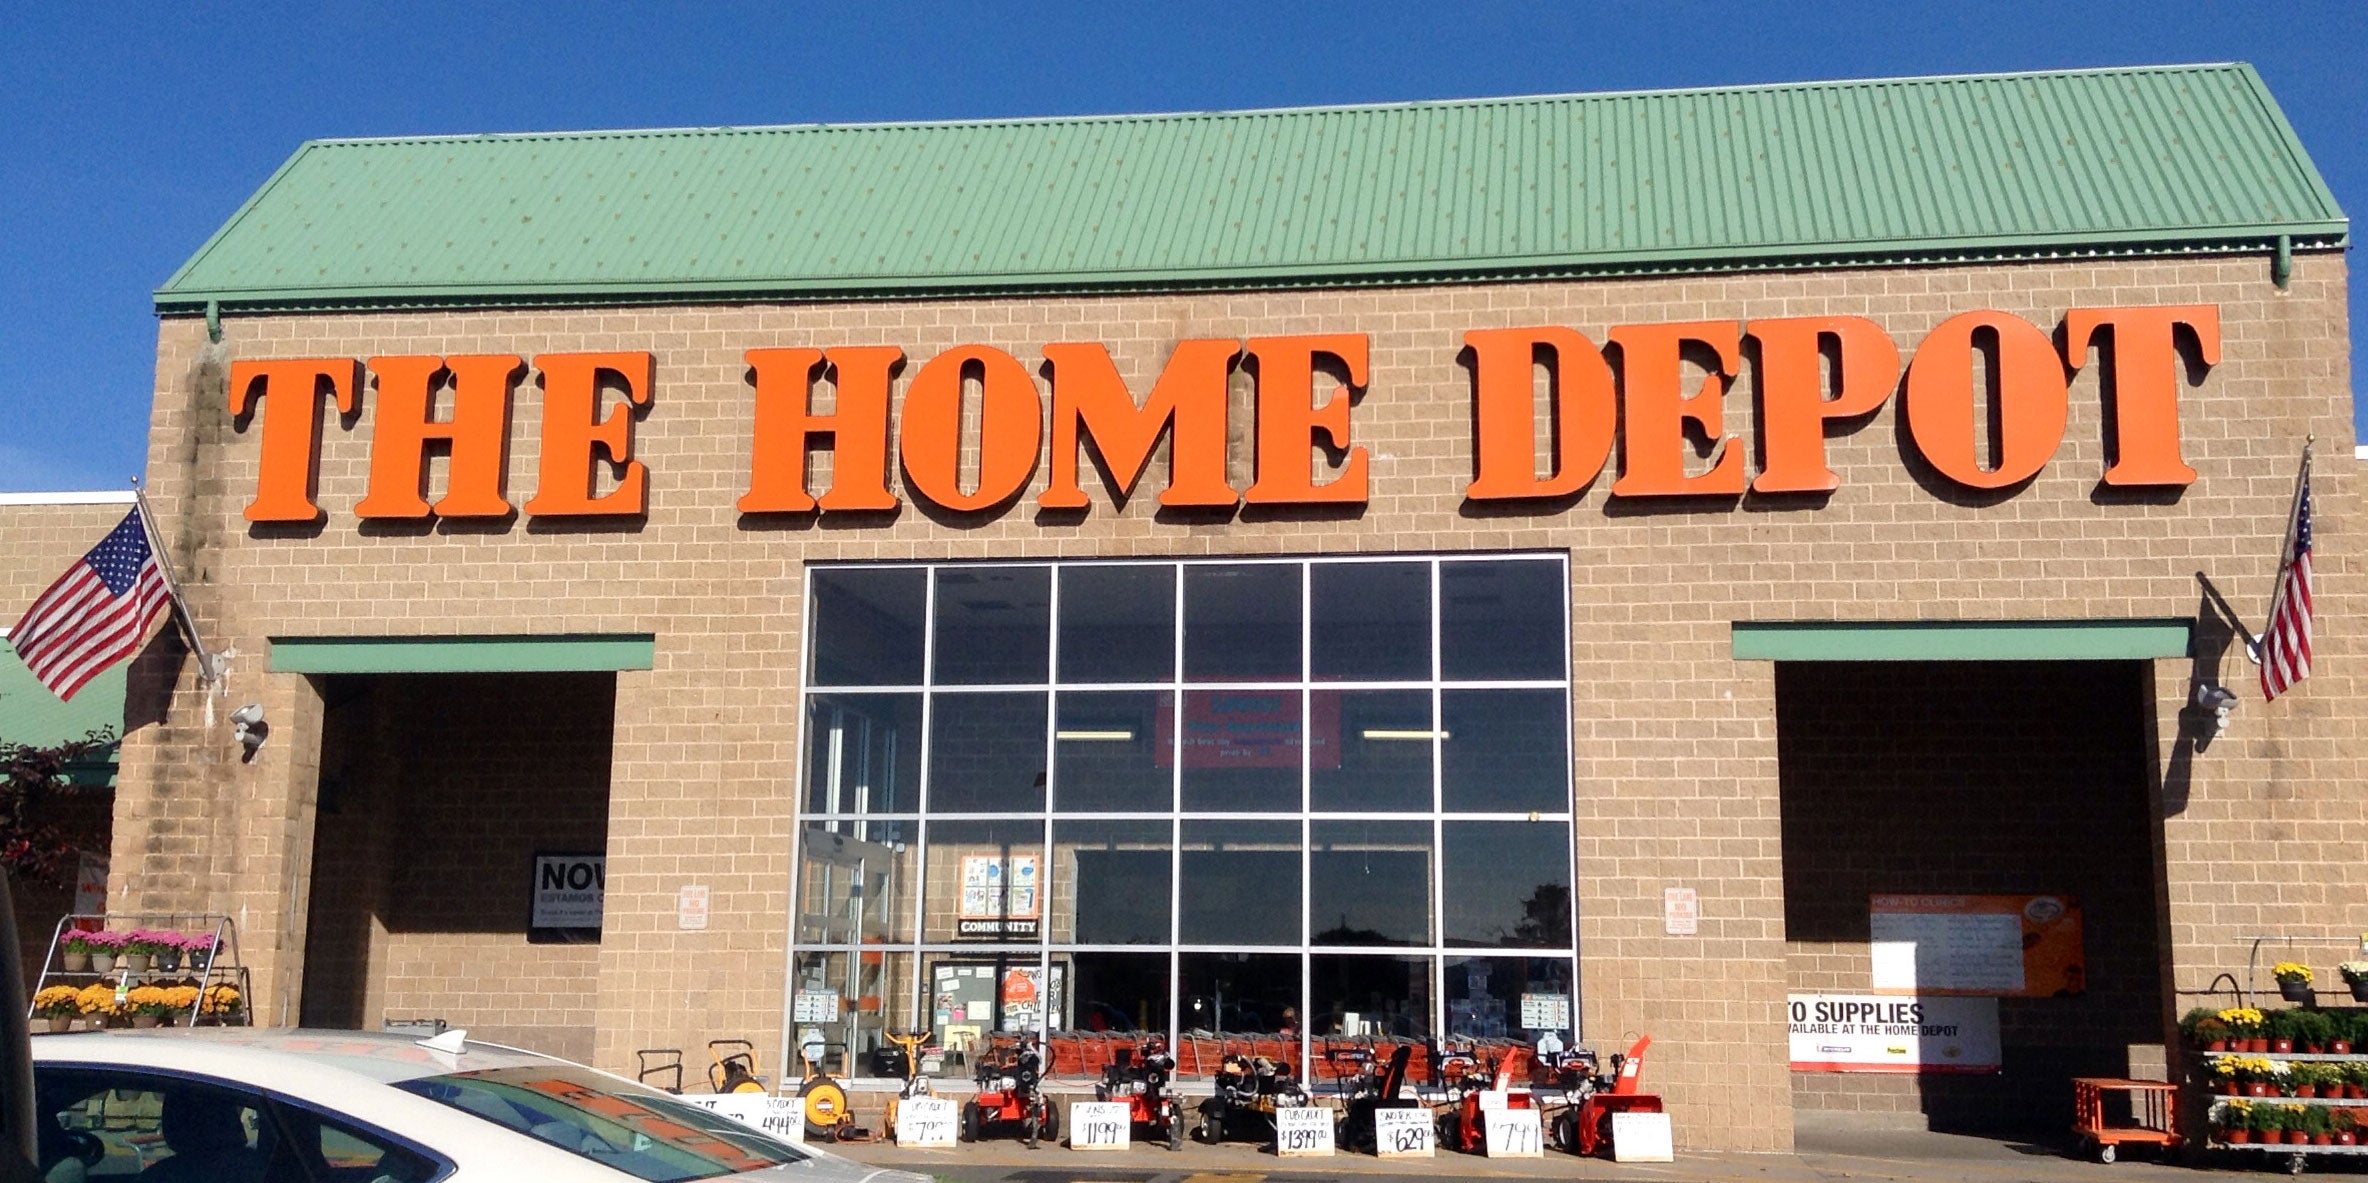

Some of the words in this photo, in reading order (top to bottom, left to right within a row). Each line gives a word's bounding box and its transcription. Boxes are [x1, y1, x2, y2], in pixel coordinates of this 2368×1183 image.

[228, 351, 651, 521] THE
[736, 333, 1369, 513] HOME
[1463, 303, 2220, 500] DEPOT
[960, 921, 1036, 933] COMMUNITY
[1021, 1000, 1061, 1014] CHILEN
[1788, 1001, 1807, 1022] O
[1815, 1001, 1925, 1024] SUPPLIES
[1842, 1024, 1855, 1034] AT
[1860, 1024, 1880, 1035] THE
[1885, 1025, 1918, 1036] HOME
[1921, 1025, 1959, 1037] DEPOT
